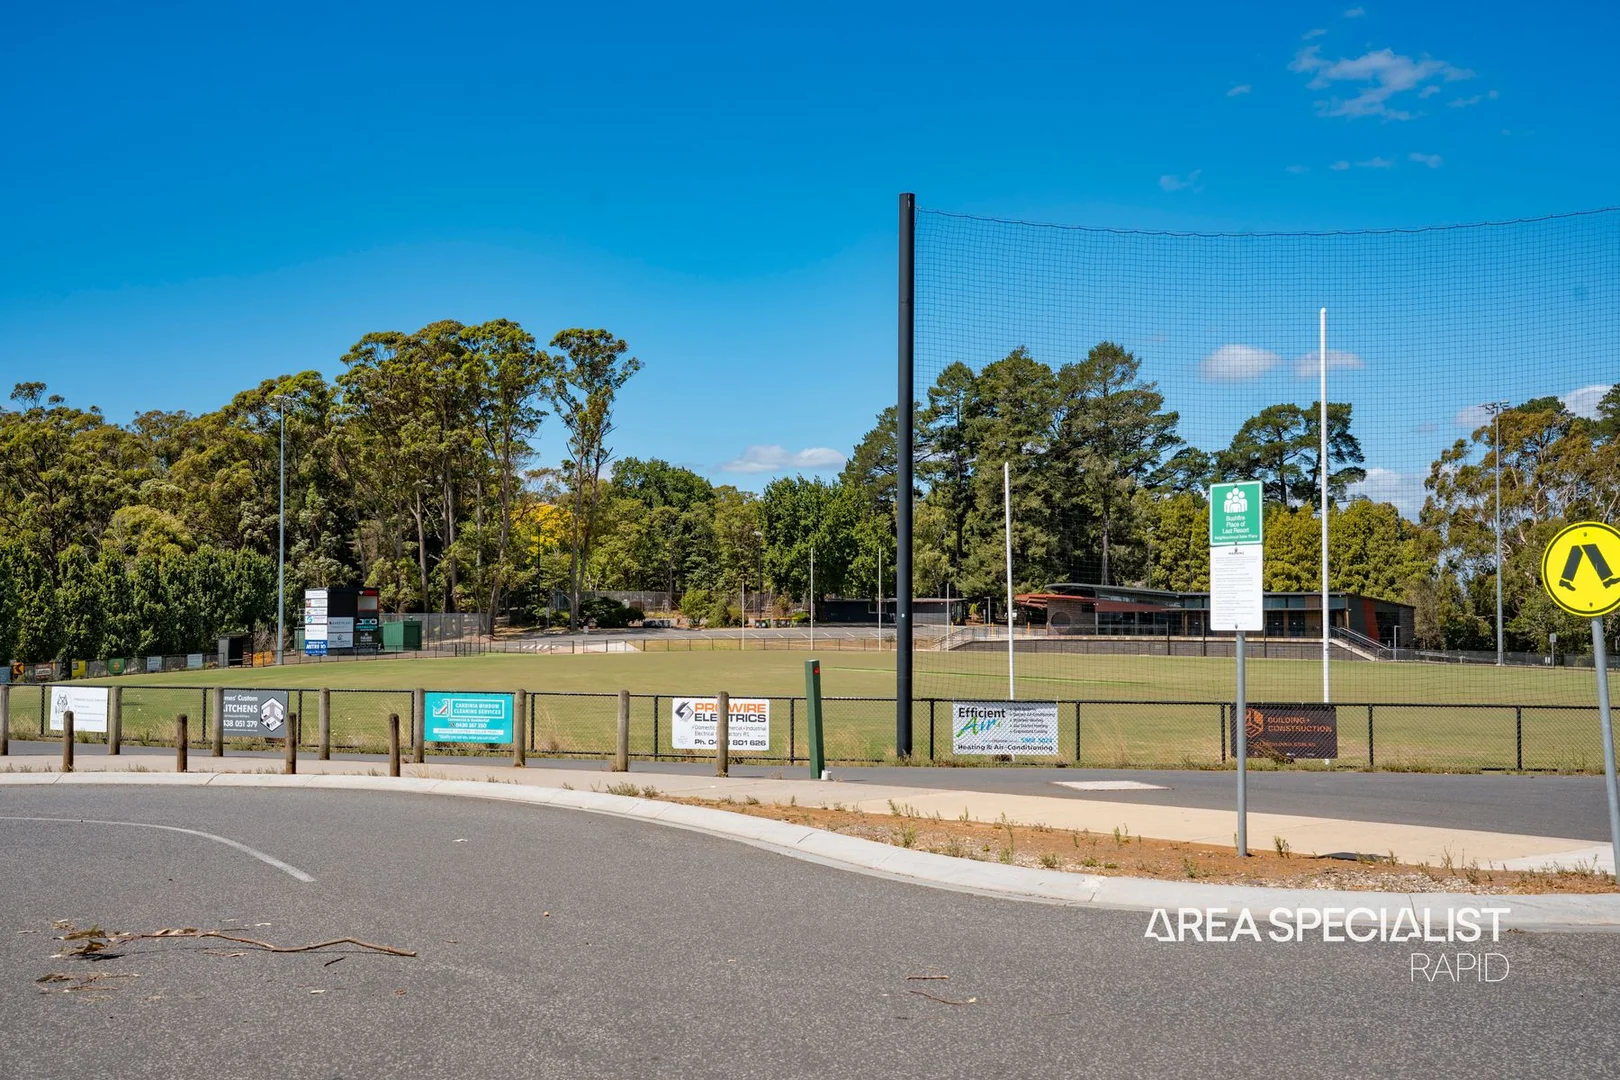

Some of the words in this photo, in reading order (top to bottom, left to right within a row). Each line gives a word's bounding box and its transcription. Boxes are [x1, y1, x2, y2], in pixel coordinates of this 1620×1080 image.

[695, 703, 767, 713] PRWIRE
[958, 707, 1006, 718] Efficient
[694, 713, 767, 722] ELETRICS
[235, 720, 246, 728] 051
[246, 720, 258, 728] 379
[956, 716, 998, 738] Air
[1267, 725, 1332, 733] CONSTRUCTION
